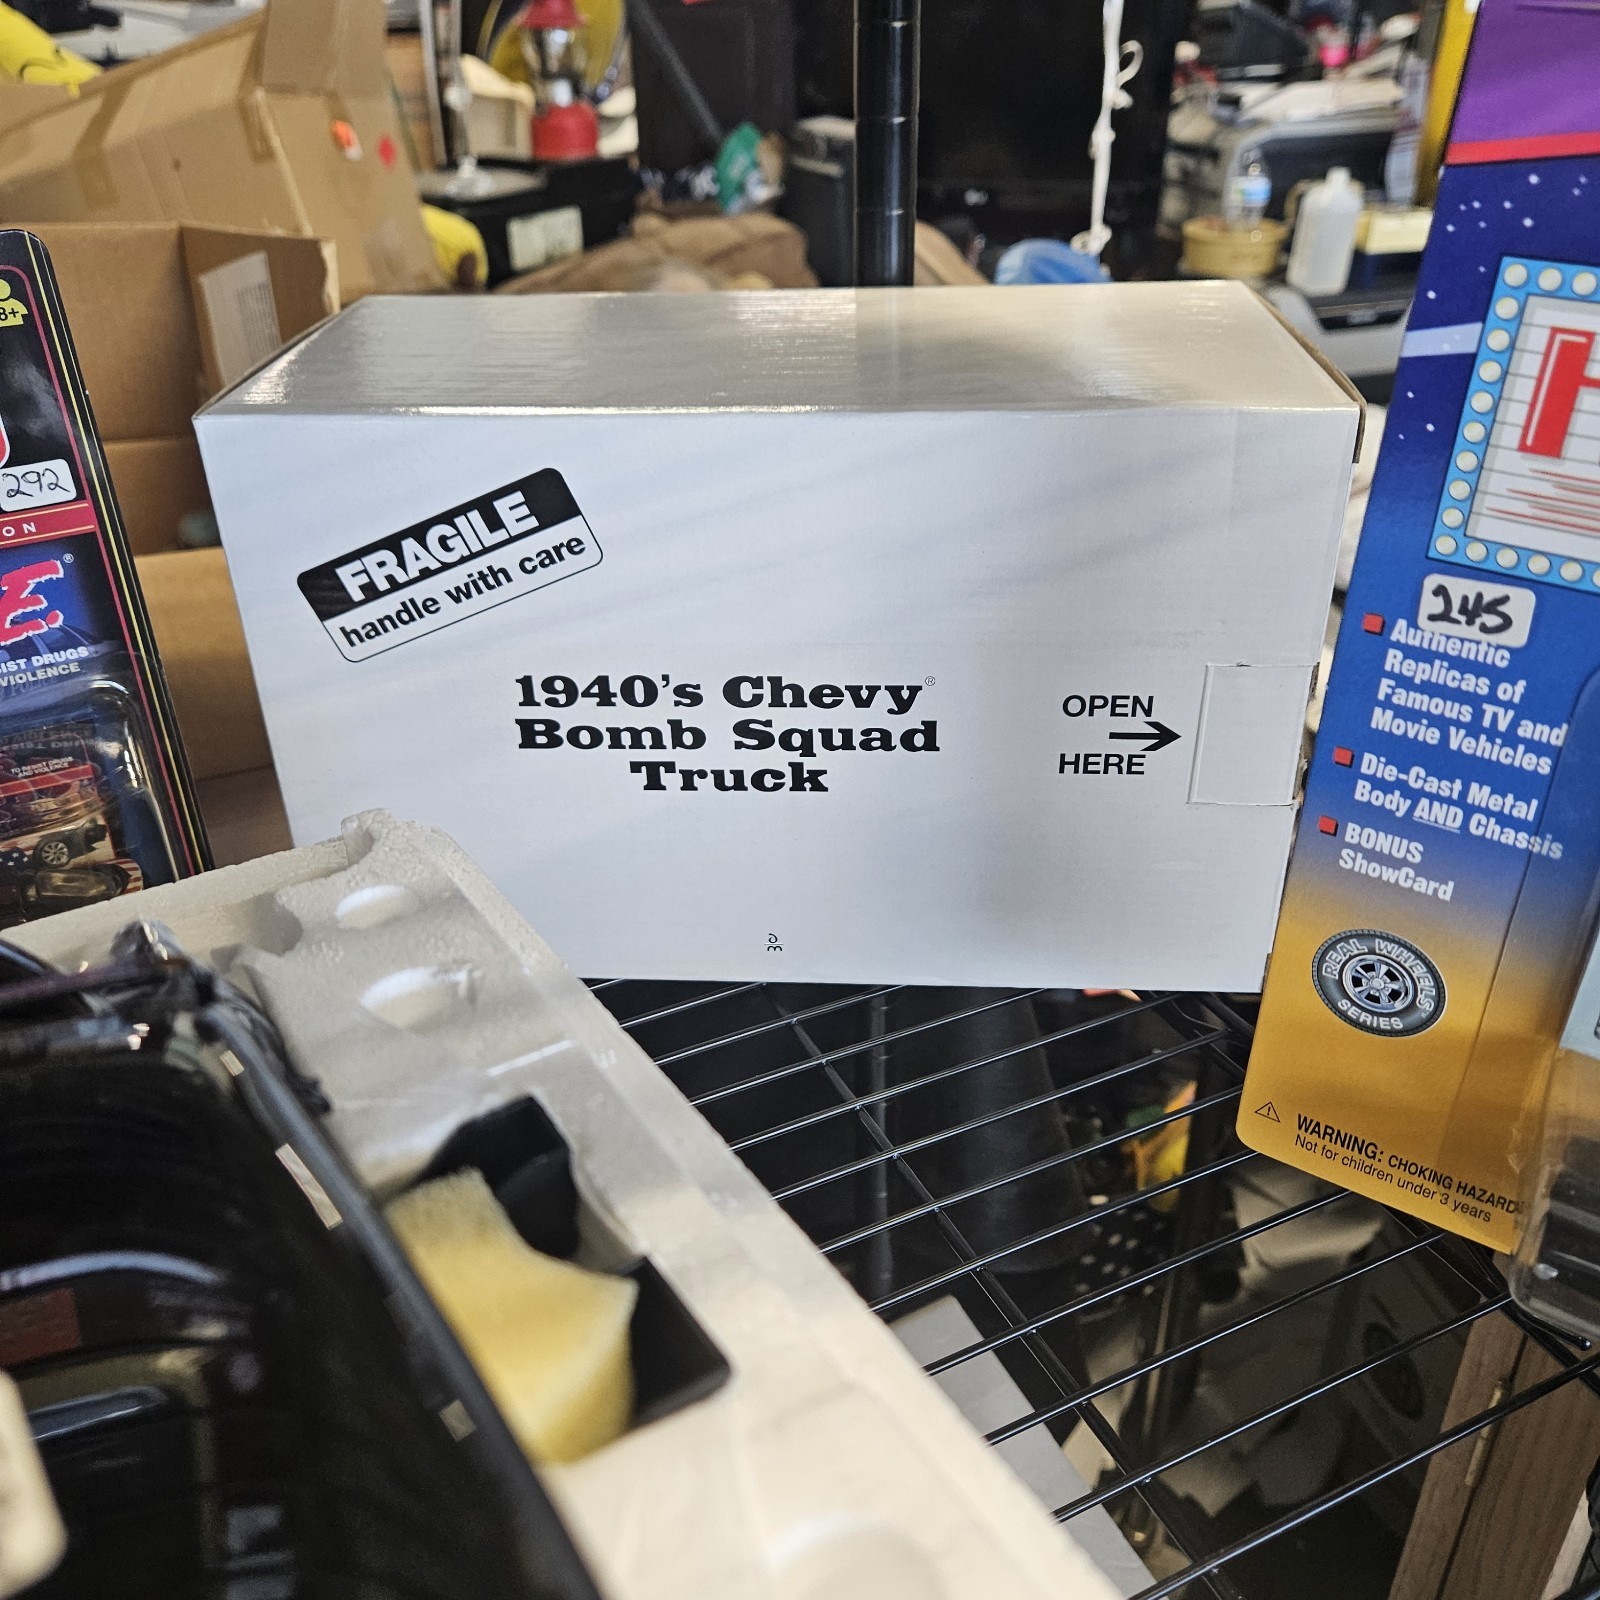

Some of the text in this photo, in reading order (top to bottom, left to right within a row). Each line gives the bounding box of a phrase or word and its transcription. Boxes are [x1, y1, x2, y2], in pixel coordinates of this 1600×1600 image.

[1, 468, 70, 498] 292
[334, 490, 539, 602] FRAGILE
[339, 537, 587, 647] handle with care
[1426, 583, 1514, 634] 245
[31, 646, 89, 667] DRUGS
[1390, 618, 1511, 669] Authentic
[0, 662, 80, 687] VIOLENCE
[515, 674, 704, 708] 1940's
[1384, 648, 1527, 704] Replicas of
[1062, 695, 1154, 718] OPEN
[1377, 678, 1569, 747] Famous TV and
[515, 718, 940, 757] Bomb Squad
[1370, 707, 1552, 776] Movie Vehicles
[629, 761, 829, 792] Truck
[1058, 753, 1147, 775] HERE
[1360, 752, 1539, 822] Die-Cast Metal
[1344, 822, 1424, 864] BONUS
[1354, 779, 1564, 860] Body AND Chassis
[1338, 848, 1455, 902] ShowCard
[1322, 938, 1436, 1013] REAL WHEELS
[1337, 999, 1404, 1029] SERIES
[1297, 1113, 1384, 1163] WARNING:
[1388, 1154, 1453, 1190] CHOKING
[1294, 1133, 1492, 1223] Not for children under 3 years
